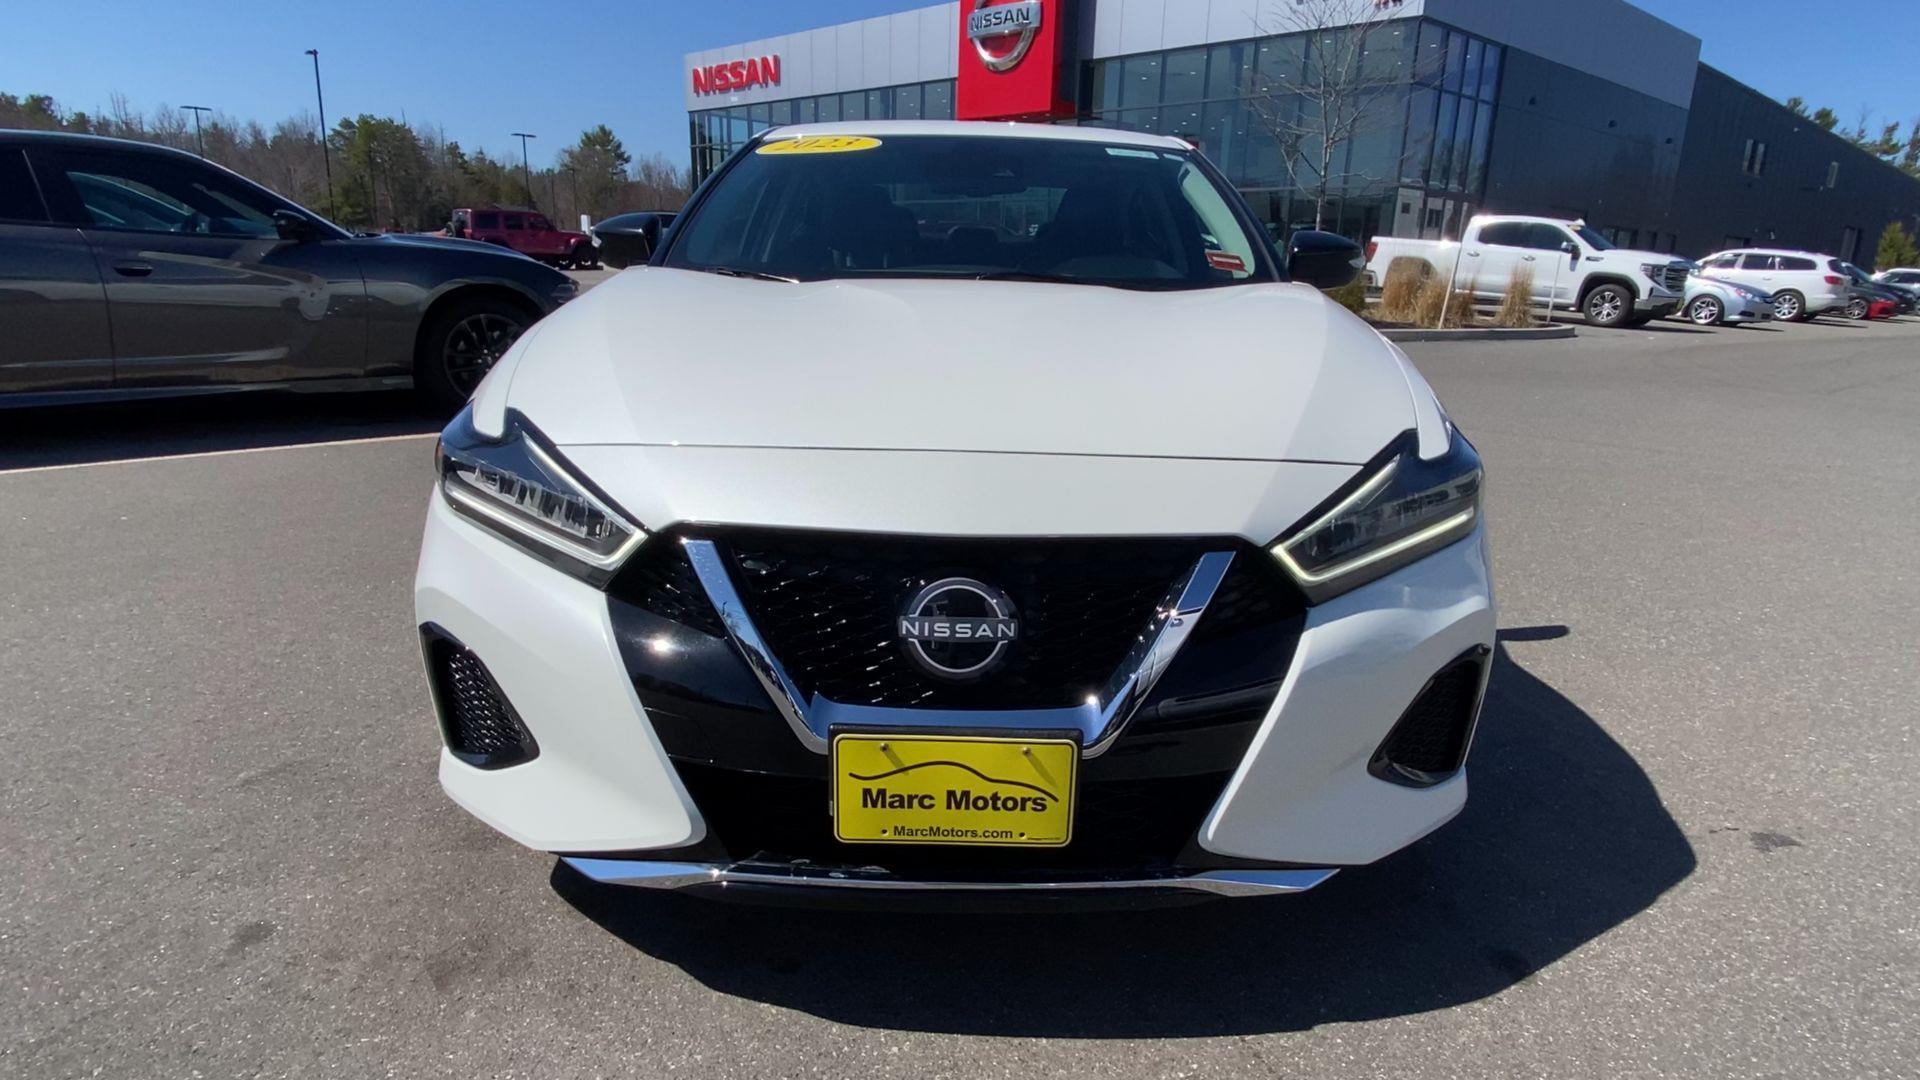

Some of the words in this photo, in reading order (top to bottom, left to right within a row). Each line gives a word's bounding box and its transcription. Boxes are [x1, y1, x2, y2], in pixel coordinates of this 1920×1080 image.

[970, 7, 1030, 31] NISSAN
[692, 54, 781, 97] NISSAN
[901, 620, 1015, 638] NISSAN
[862, 788, 935, 810] Marc
[946, 790, 1048, 812] Motors
[893, 826, 1013, 838] MarcMotors.com
